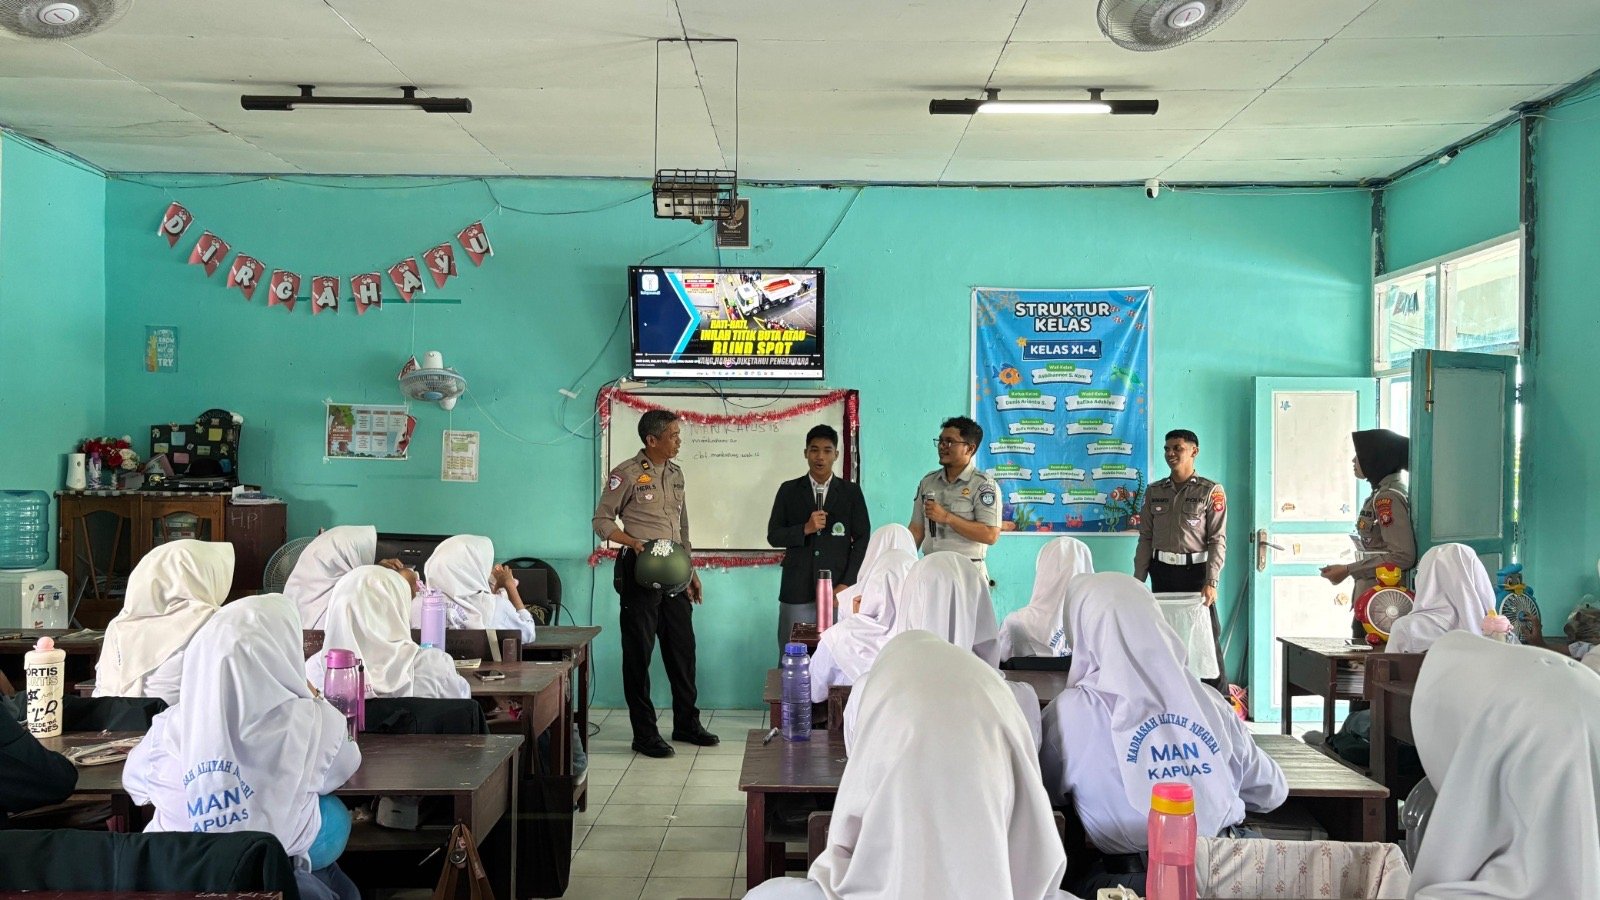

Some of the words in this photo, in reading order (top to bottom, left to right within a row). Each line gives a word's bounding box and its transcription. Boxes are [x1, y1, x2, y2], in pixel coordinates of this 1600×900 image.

[164, 214, 489, 307] DIRGAHAYU
[1015, 302, 1110, 317] STRUKTUR
[1035, 317, 1091, 332] KELAS
[732, 330, 756, 341] TITIK
[757, 330, 781, 341] BUTA
[782, 330, 807, 341] ATAU
[712, 341, 754, 355] BLIND
[756, 341, 793, 355] SPOT
[1030, 345, 1069, 355] KELAS
[1071, 345, 1097, 355] XI-4
[157, 358, 173, 367] TRY
[26, 667, 58, 677] ORTIS
[1126, 717, 1159, 764] MADRASAH
[1157, 713, 1189, 728] ALIYAH
[1189, 721, 1221, 755] NEGERI
[1150, 742, 1200, 763] MAN
[197, 759, 233, 776] ALIYAH
[1147, 763, 1212, 780] KAPUAS
[186, 787, 241, 818] MAN
[193, 808, 249, 832] APUAS
